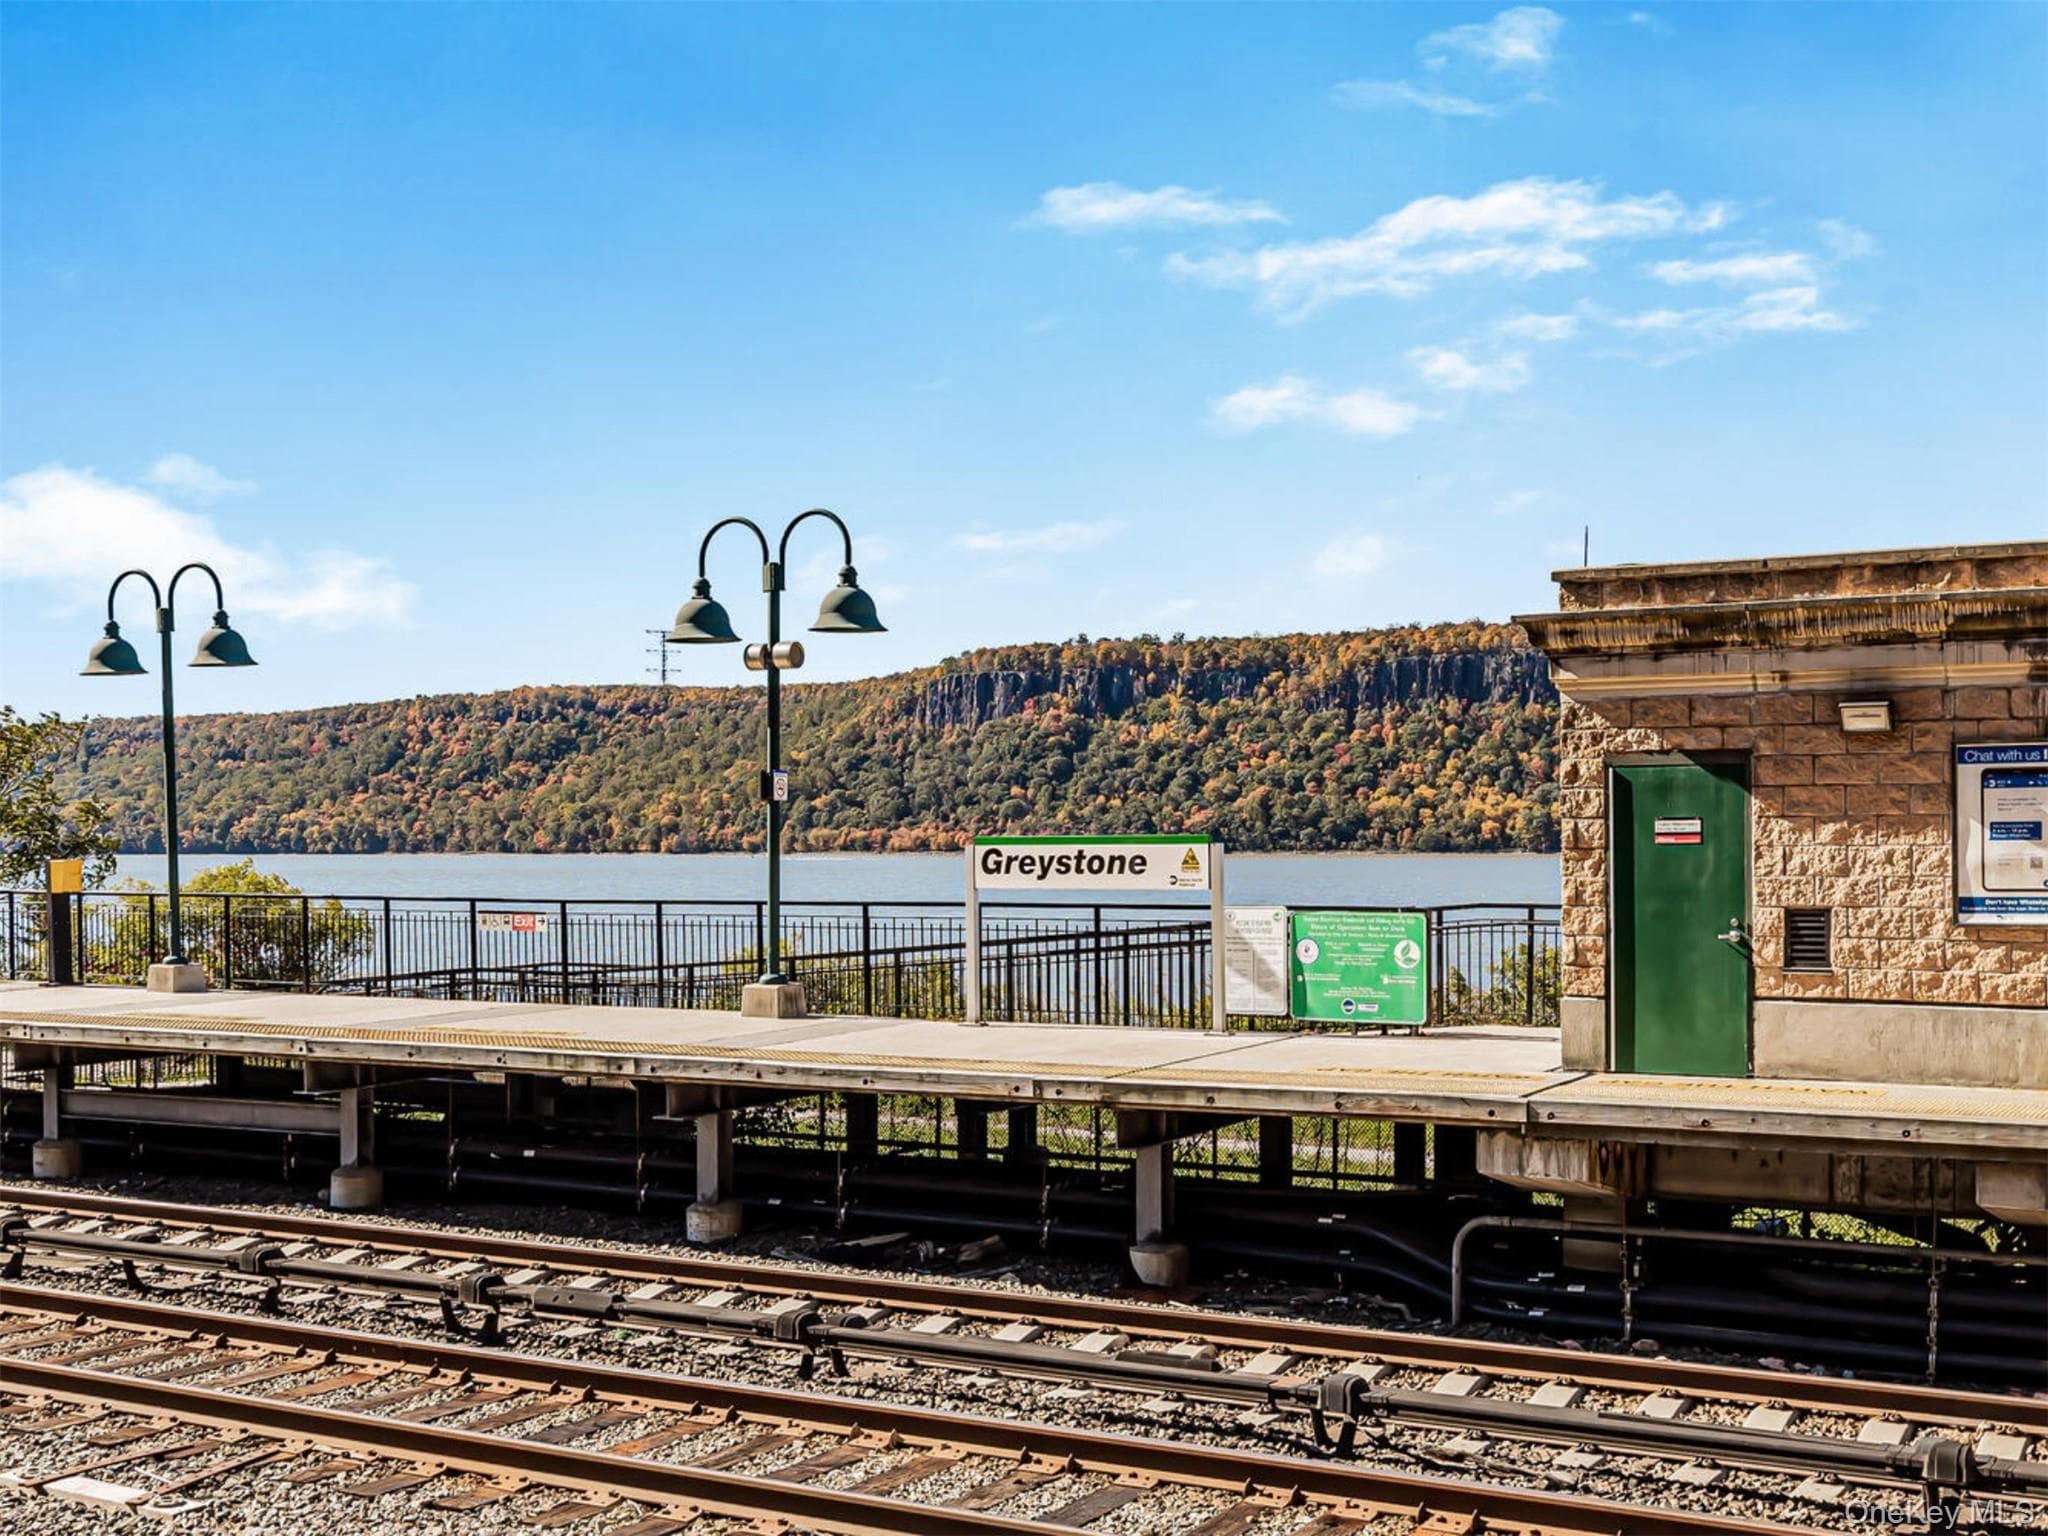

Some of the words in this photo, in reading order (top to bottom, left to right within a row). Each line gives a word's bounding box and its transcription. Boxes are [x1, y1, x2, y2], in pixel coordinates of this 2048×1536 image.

[1964, 750, 1994, 762] Chat
[1996, 749, 2022, 761] with
[2025, 751, 2041, 761] us
[981, 848, 1148, 880] Greystone
[513, 914, 533, 927] Exit
